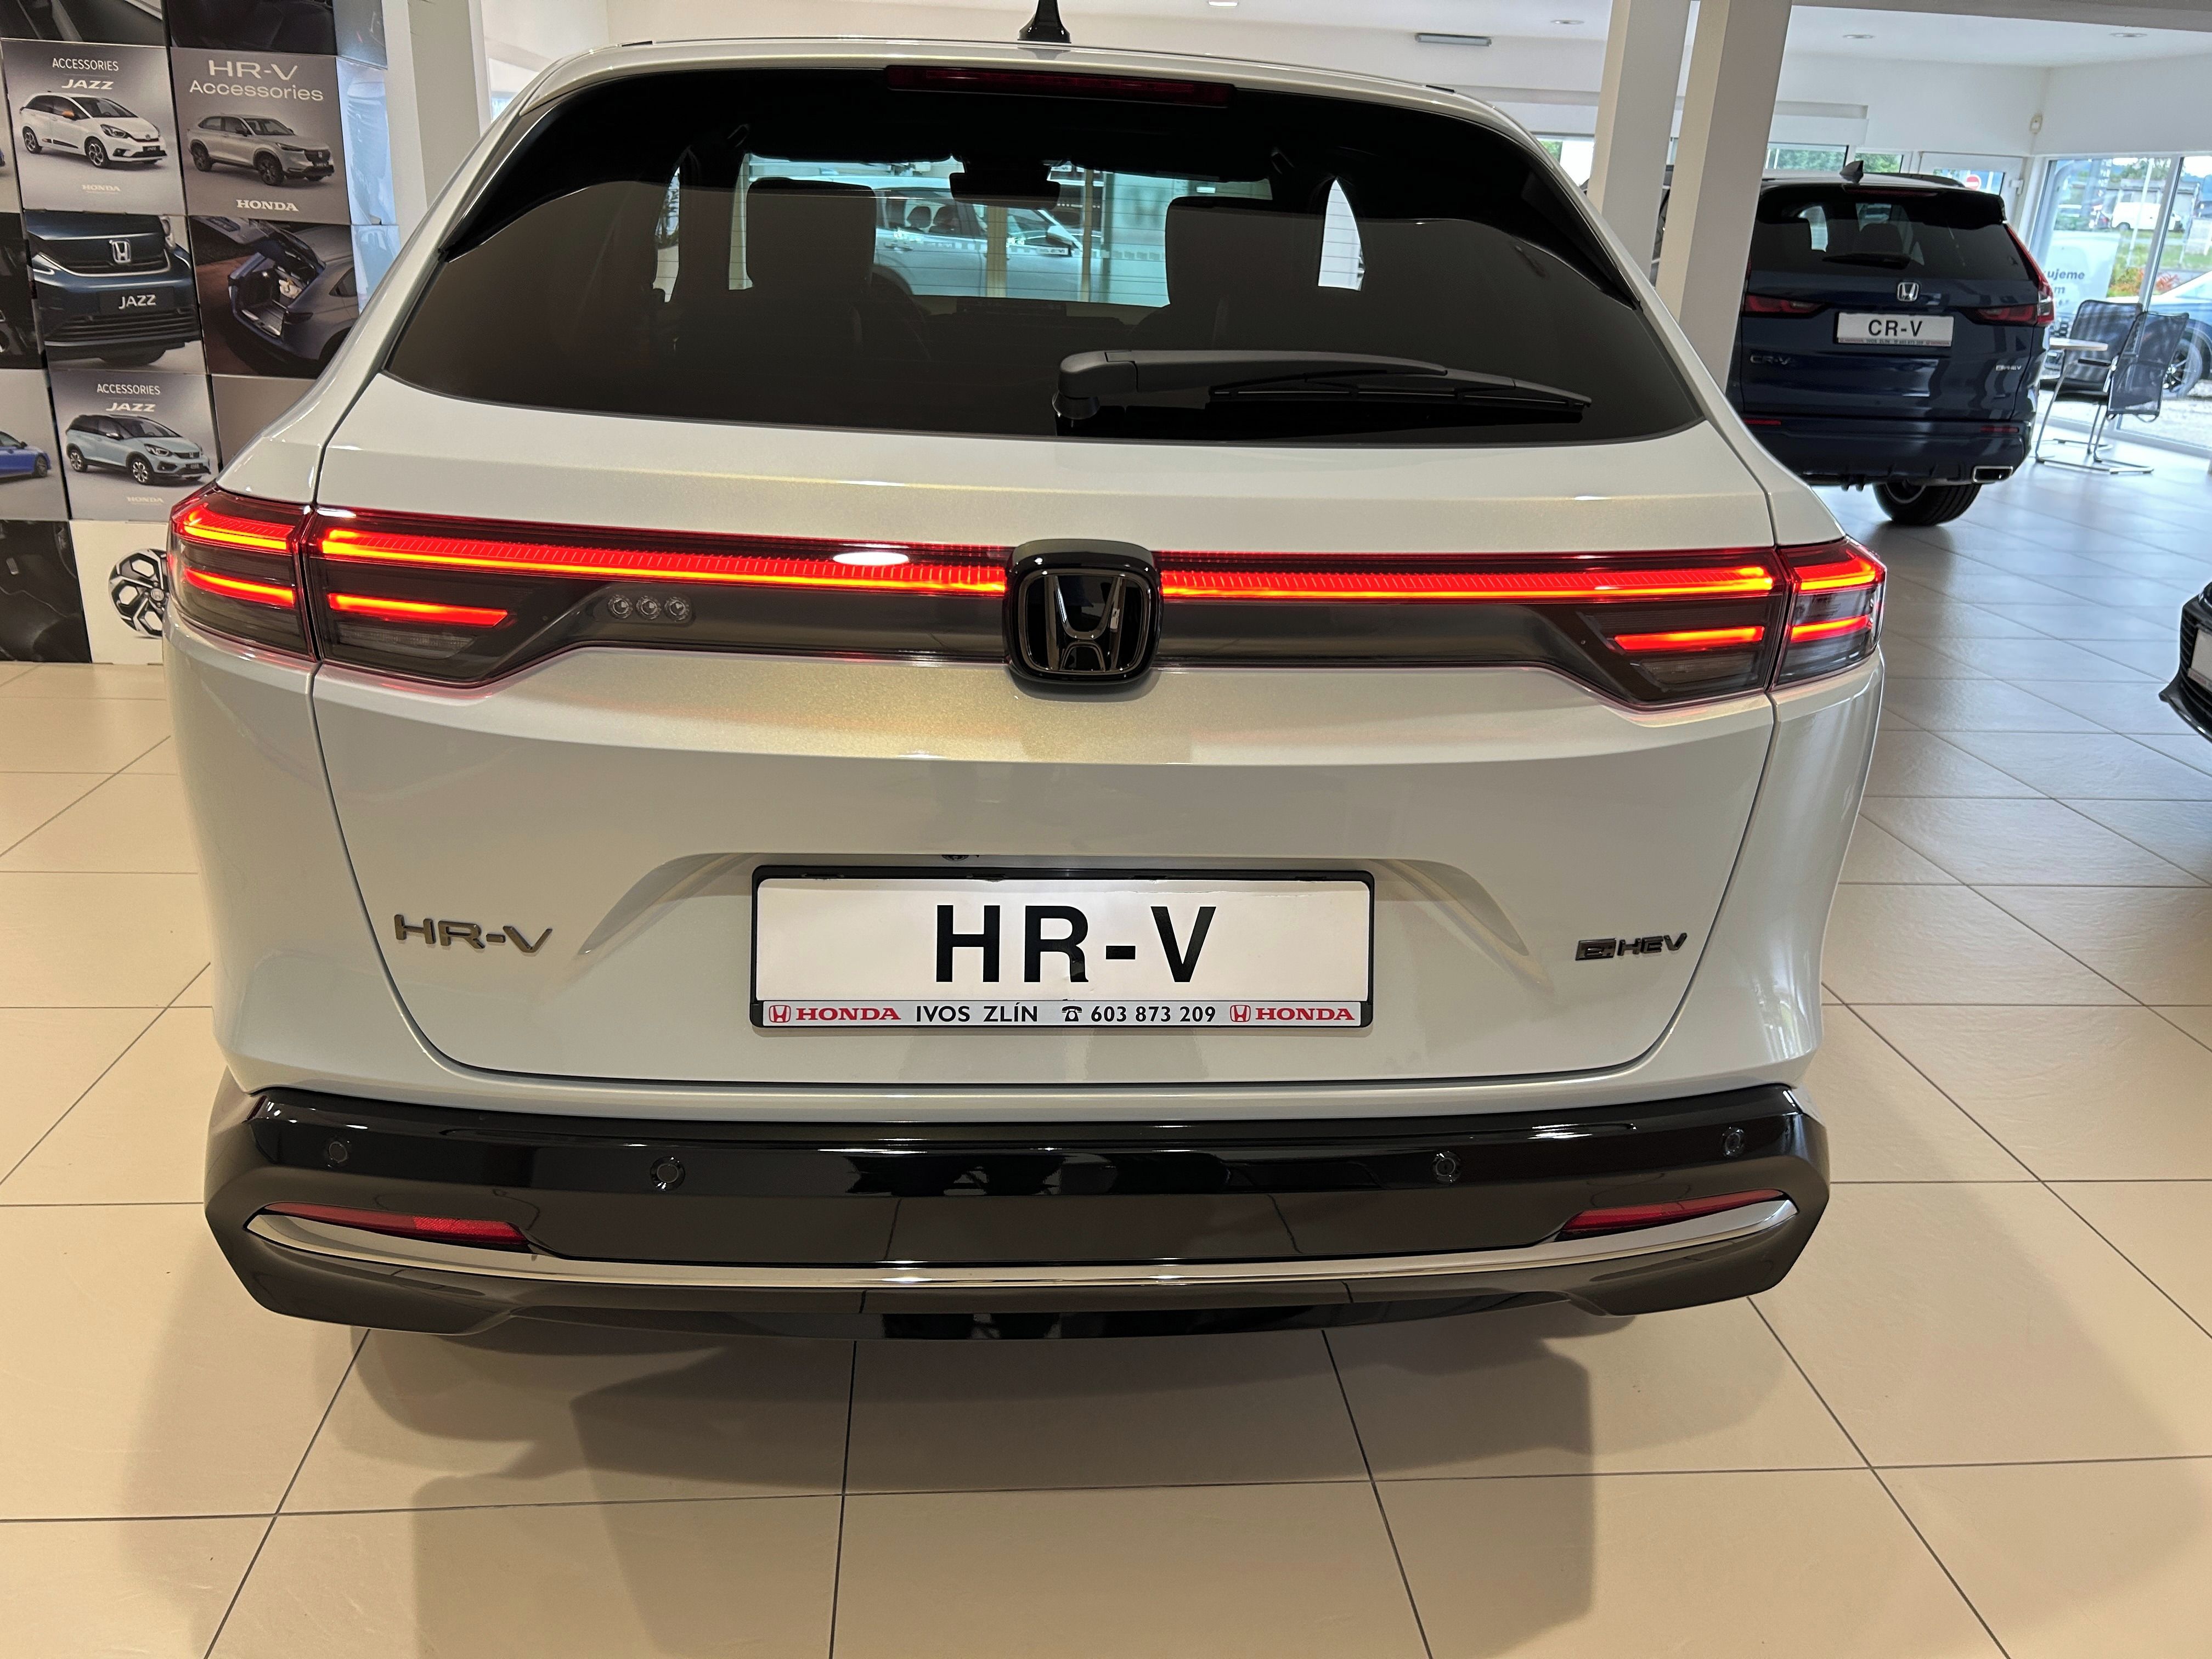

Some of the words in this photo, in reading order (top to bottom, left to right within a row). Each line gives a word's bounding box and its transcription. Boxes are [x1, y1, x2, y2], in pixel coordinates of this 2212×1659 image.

[52, 58, 119, 71] ACCESSORIES
[208, 60, 298, 81] HR-V
[61, 79, 114, 89] JAZZ
[189, 80, 324, 101] Accessories
[236, 199, 299, 212] HONDA
[2045, 269, 2085, 280] ujeme
[119, 294, 156, 309] JAZZ
[1868, 319, 1923, 337] CR-V
[97, 383, 161, 395] ACCESSORIES
[105, 402, 156, 412] JAZZ
[394, 914, 553, 953] HR-V
[935, 904, 1217, 983] HR-V
[795, 1008, 901, 1020] HONDA
[916, 1005, 970, 1022] IVOS
[983, 1002, 1037, 1022] ZLÍN
[1091, 1006, 1127, 1022] 603
[1135, 1006, 1171, 1022] 873
[1180, 1006, 1216, 1022] 209
[1255, 1008, 1355, 1020] HONDA
